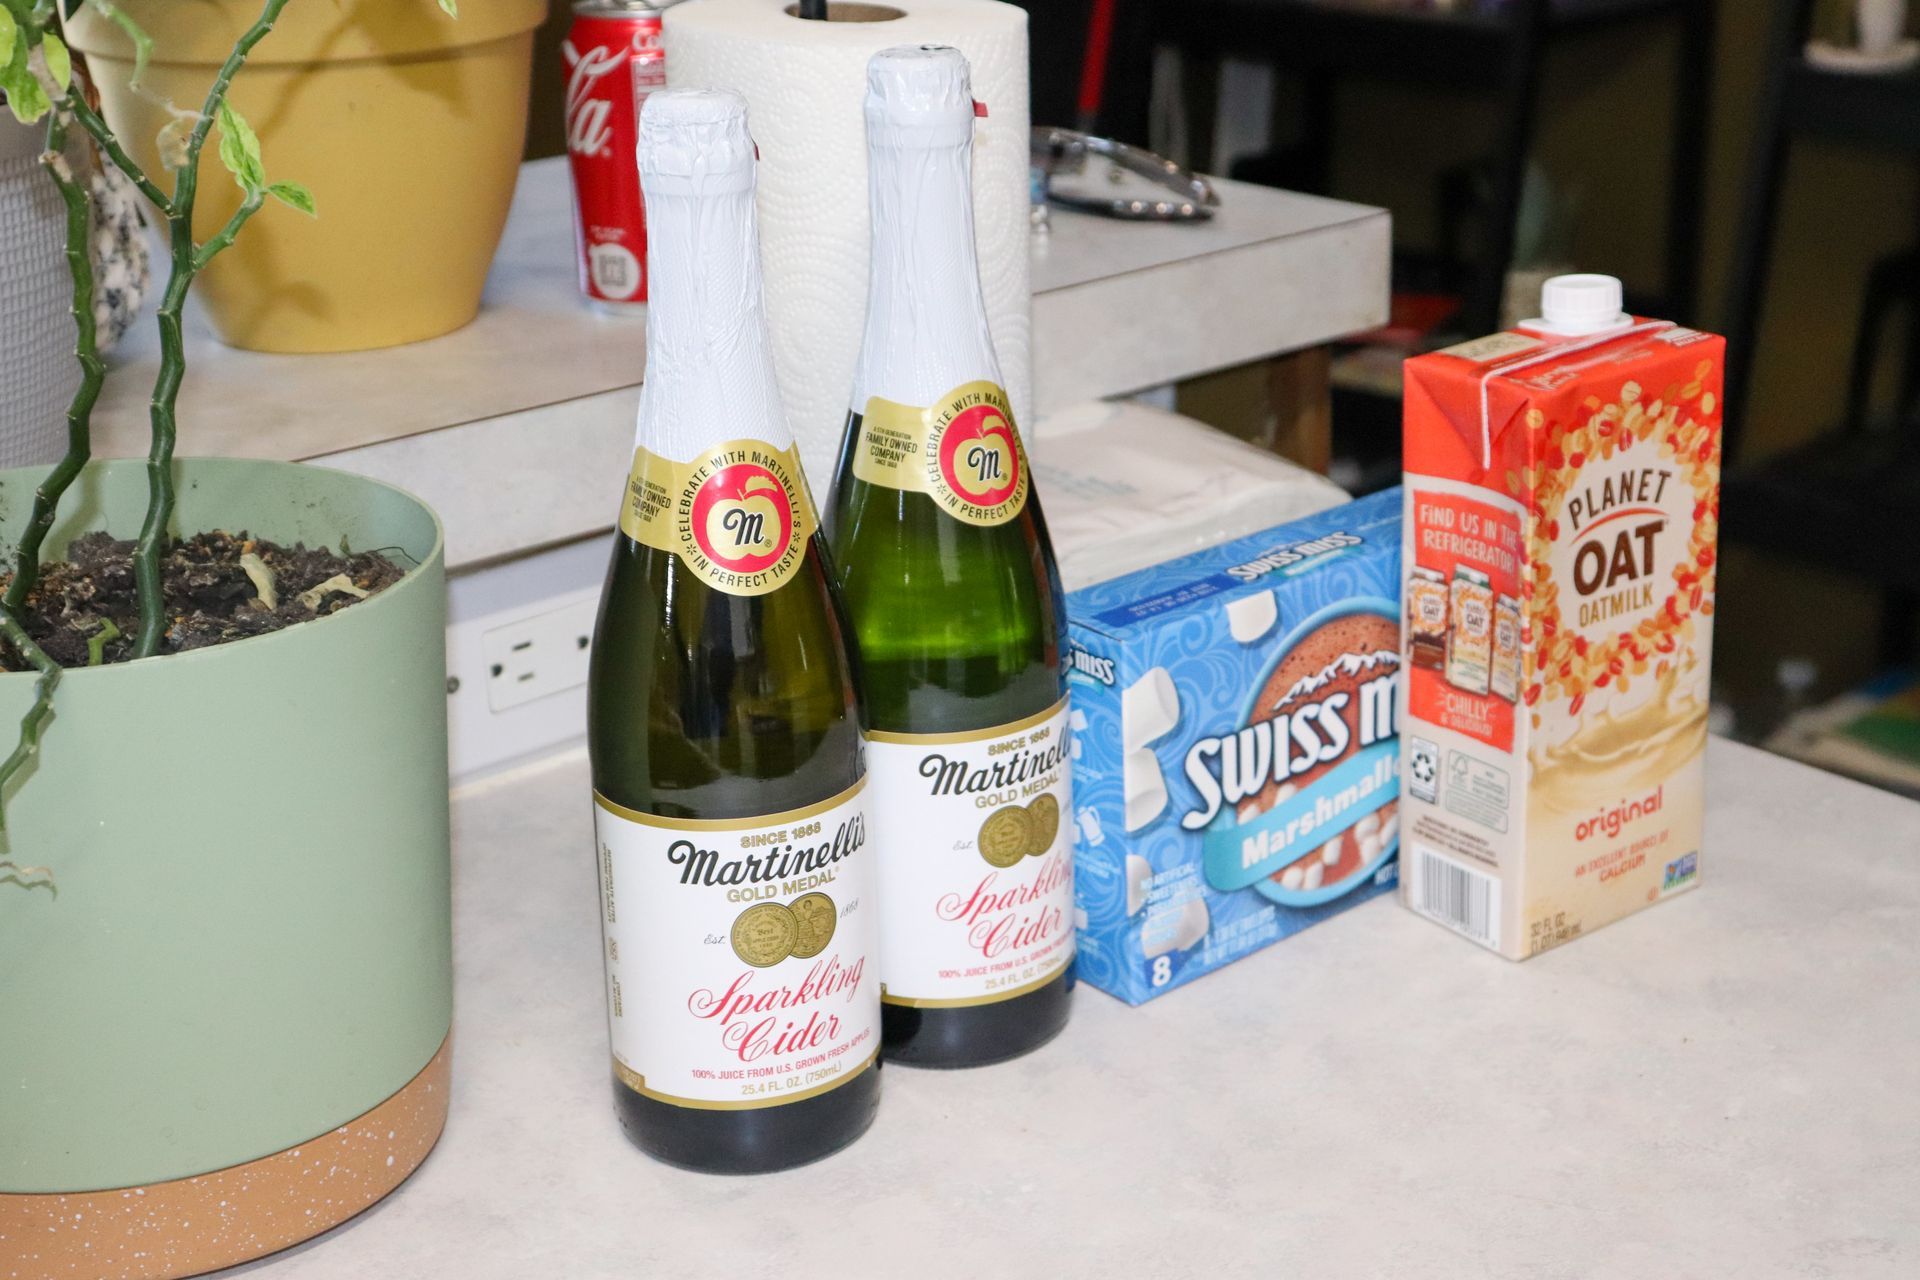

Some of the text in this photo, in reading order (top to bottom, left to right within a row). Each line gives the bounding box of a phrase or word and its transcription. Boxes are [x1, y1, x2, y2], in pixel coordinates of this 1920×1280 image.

[866, 432, 918, 453] FAMILY OWNED
[870, 445, 906, 462] COMPANY
[927, 410, 952, 483] CELEBRATE
[952, 393, 980, 412] WITH
[646, 490, 671, 508] OWNED
[679, 451, 801, 541] CELEBRATE WITH MARTINELLI'S
[944, 493, 958, 507] IN
[960, 504, 1008, 520] PERFECT
[1568, 469, 1672, 531] PLANET
[1420, 504, 1518, 551] FIND US IN THE
[693, 545, 798, 587] IN PERFECT TASTE
[1574, 519, 1664, 596] OAT
[1579, 582, 1653, 628] OATMILK
[987, 737, 1026, 757] SINCE
[1181, 691, 1350, 830] SWISS
[975, 774, 1059, 809] GOLD MEDAL
[1575, 784, 1663, 842] original
[667, 811, 866, 886] Martinelli's
[740, 822, 822, 848] SINCE 1868
[727, 869, 836, 903] GOLD MEDAL
[1599, 852, 1646, 883] CALCIUM
[968, 905, 1061, 958] Cider
[688, 954, 865, 1025] Sparkling
[939, 970, 961, 978] 100%
[964, 967, 988, 977] JUICE
[990, 961, 1013, 973] FROM
[1152, 955, 1172, 987] 8
[692, 1028, 871, 1080] 100% JUICE FROM U.S. GROWN FRESH APPLES
[722, 1011, 842, 1062] Cider
[741, 1083, 765, 1095] 25.4
[768, 1081, 784, 1092] FL.
